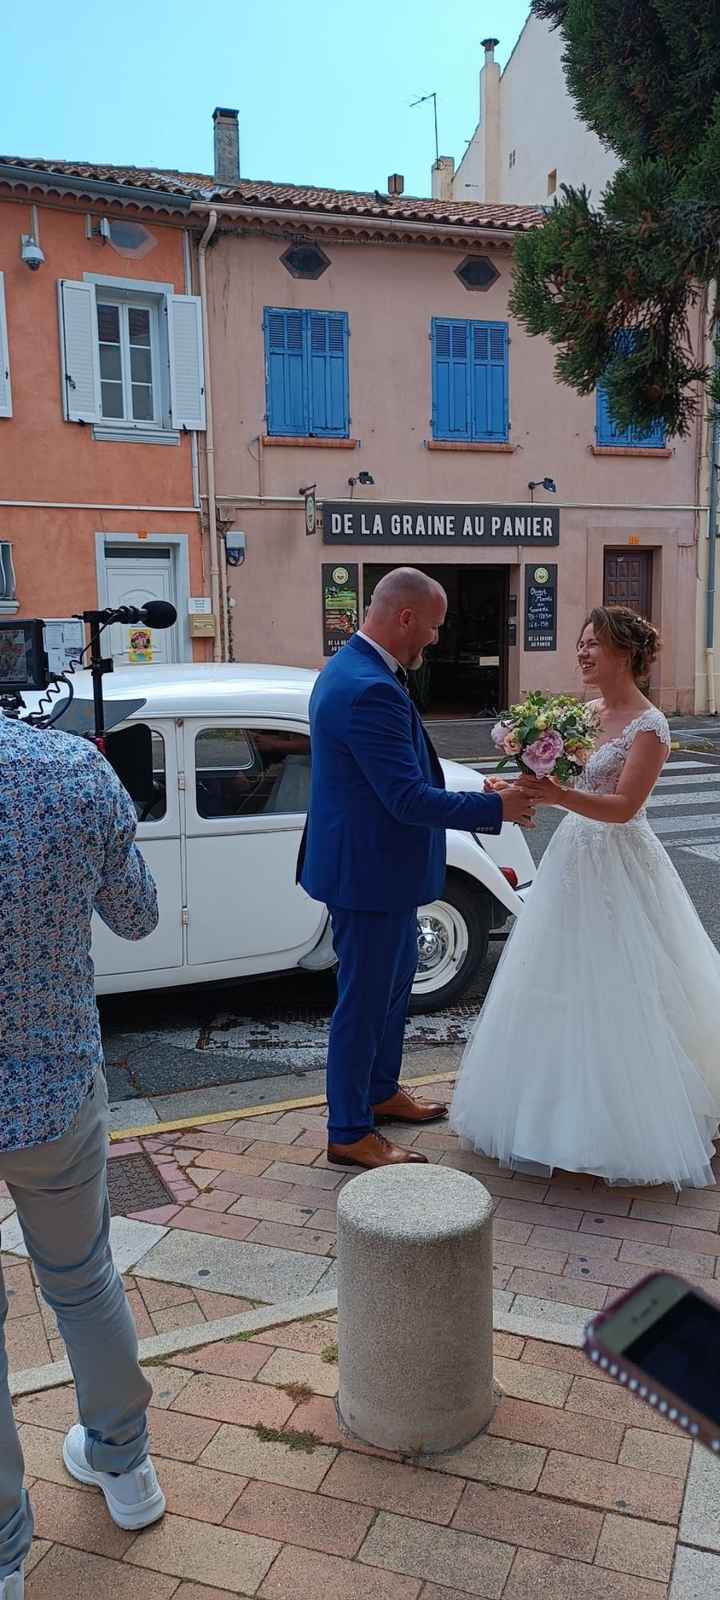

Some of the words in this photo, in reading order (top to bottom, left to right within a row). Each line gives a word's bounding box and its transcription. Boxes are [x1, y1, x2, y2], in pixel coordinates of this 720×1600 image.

[331, 513, 354, 535] DE
[360, 514, 384, 535] LA
[391, 514, 456, 536] GRAINE
[462, 516, 484, 536] AU
[491, 516, 553, 537] PANIER
